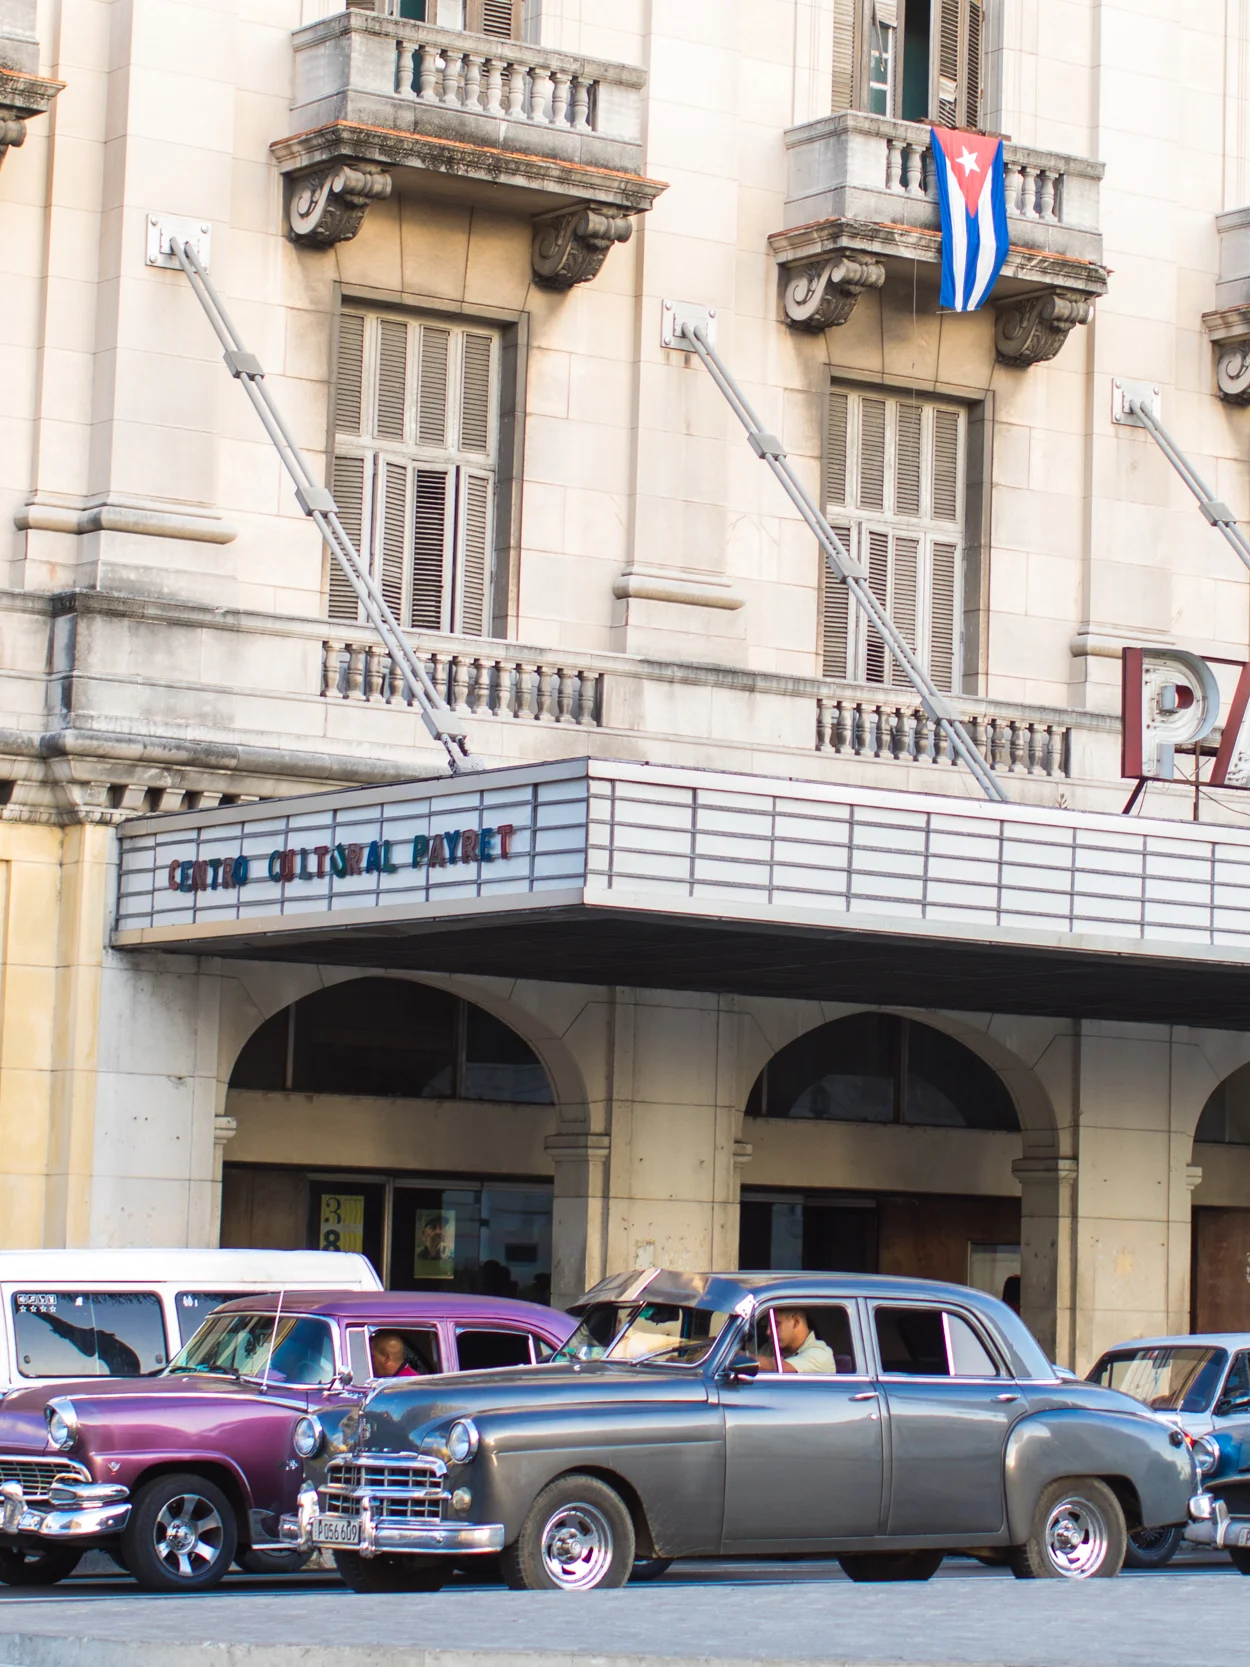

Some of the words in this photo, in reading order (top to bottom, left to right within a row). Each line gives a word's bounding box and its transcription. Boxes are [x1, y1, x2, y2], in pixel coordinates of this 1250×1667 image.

[168, 854, 248, 892] CENTRO
[268, 838, 397, 882] CULTURAL
[412, 824, 514, 869] PAYRET
